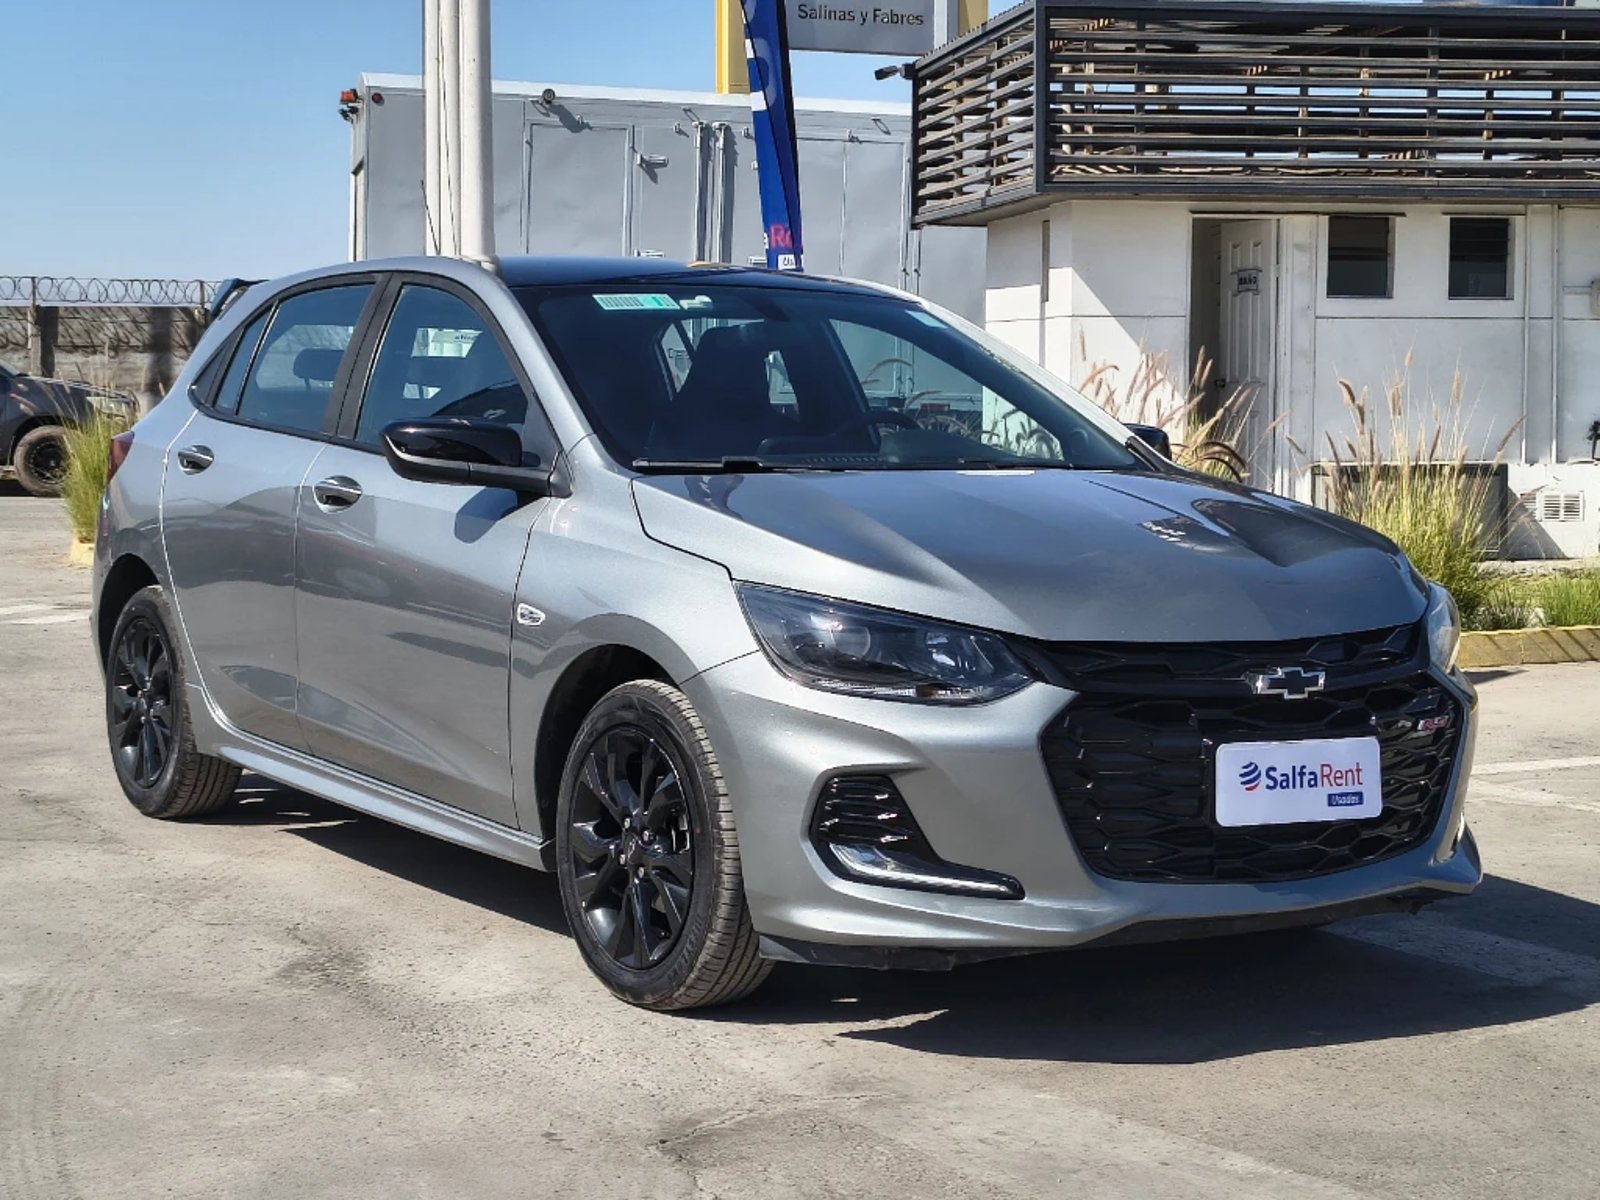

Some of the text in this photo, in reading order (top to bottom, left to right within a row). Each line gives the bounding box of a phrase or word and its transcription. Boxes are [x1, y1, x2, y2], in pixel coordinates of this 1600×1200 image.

[797, 4, 924, 26] Salinas y Fabres
[1264, 761, 1364, 791] SalfaRent
